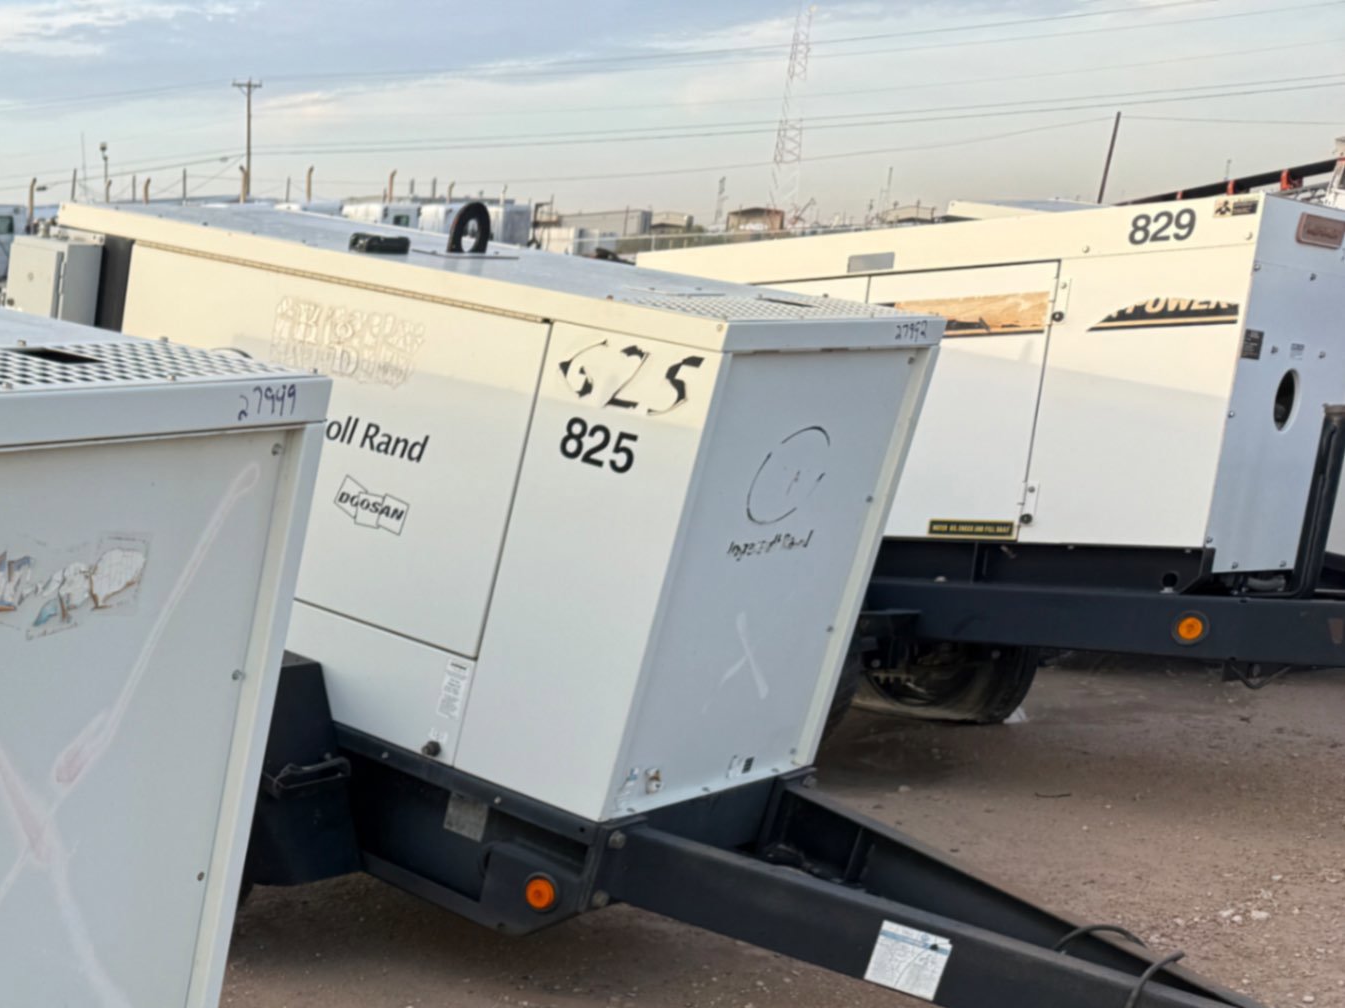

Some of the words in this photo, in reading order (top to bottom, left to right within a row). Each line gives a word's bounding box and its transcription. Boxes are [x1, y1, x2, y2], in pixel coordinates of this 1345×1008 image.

[1128, 208, 1196, 246] 829
[238, 383, 297, 421] 27949
[325, 415, 360, 445] oll
[359, 422, 430, 463] Rand
[560, 416, 639, 474] 825
[337, 491, 405, 521] DOOSAN
